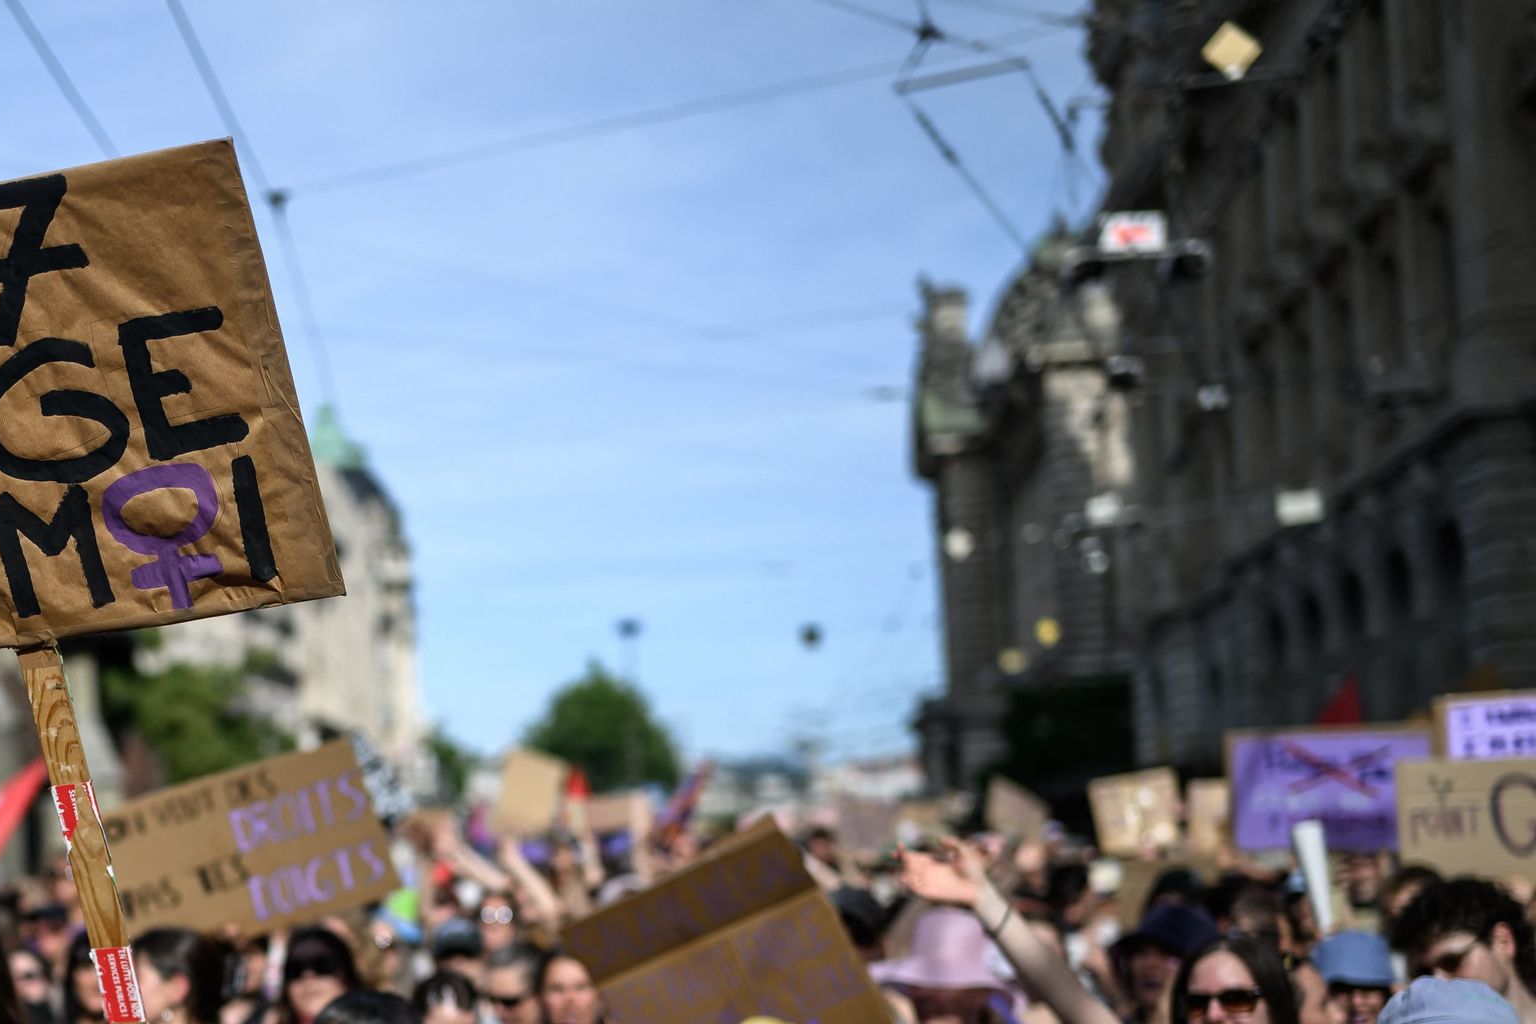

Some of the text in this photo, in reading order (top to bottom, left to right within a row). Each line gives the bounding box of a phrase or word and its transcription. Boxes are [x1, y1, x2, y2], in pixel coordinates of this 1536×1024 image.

[228, 770, 367, 855] DROITS
[107, 953, 121, 986] SERVICES
[114, 985, 128, 1013] PUBLICS
